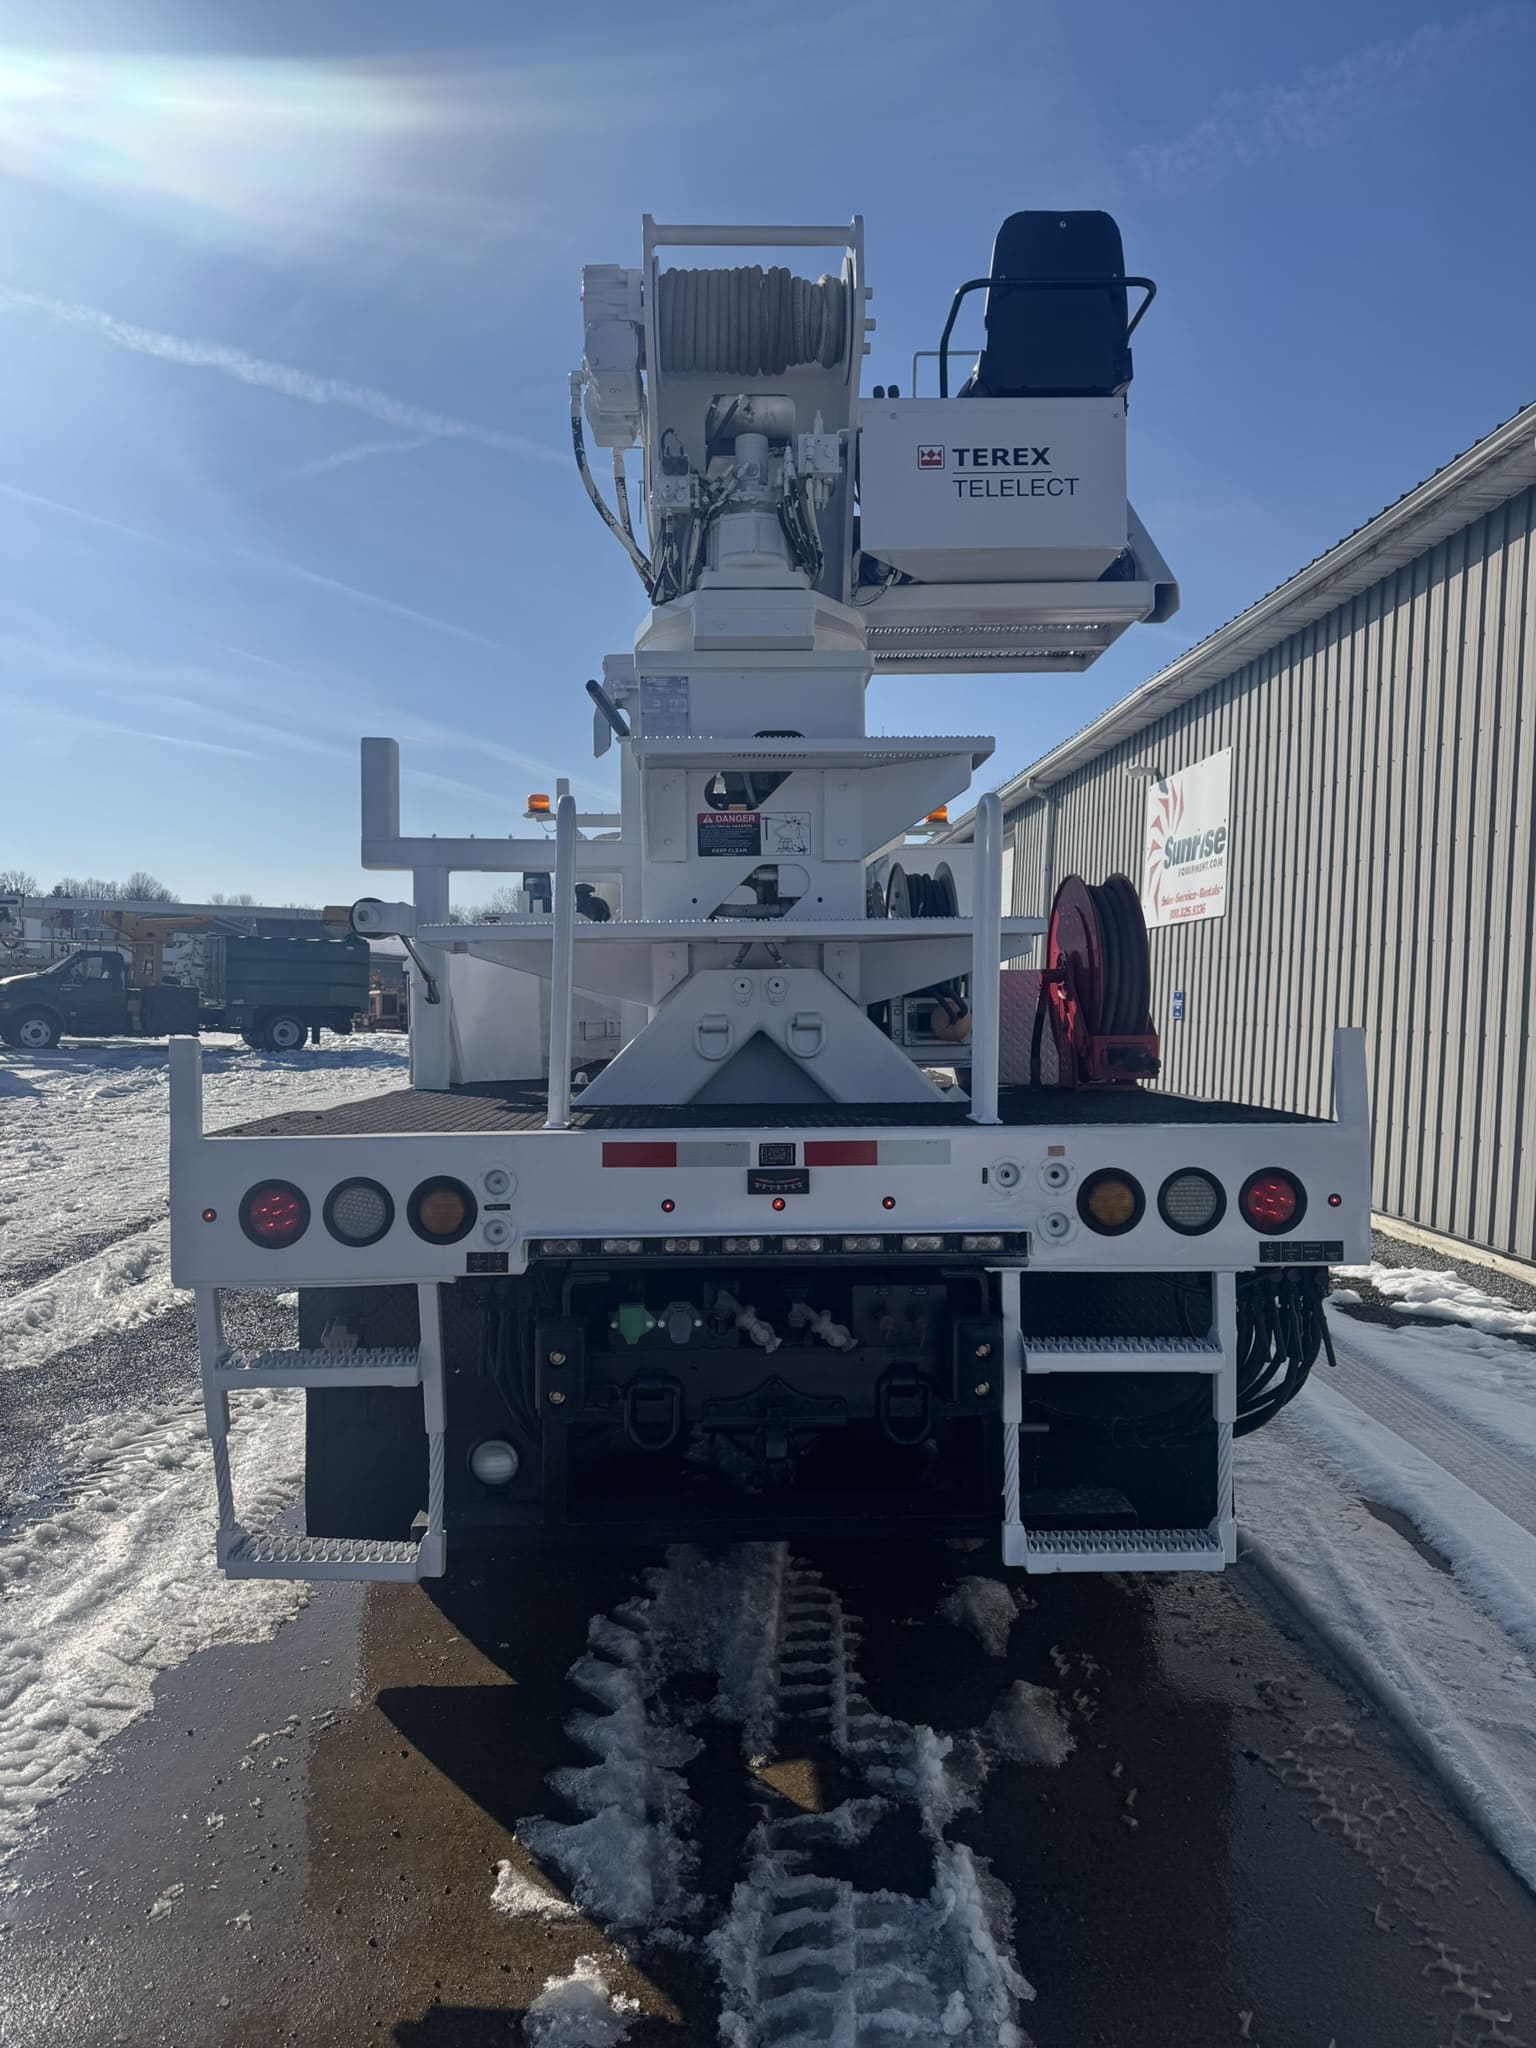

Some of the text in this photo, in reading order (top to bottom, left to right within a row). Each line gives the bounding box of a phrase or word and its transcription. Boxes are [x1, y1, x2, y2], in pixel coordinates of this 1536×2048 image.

[951, 447, 1051, 467] TEREX
[952, 477, 1080, 498] TELELECT
[715, 814, 756, 823] DANGER
[1163, 826, 1227, 870] Sunrise
